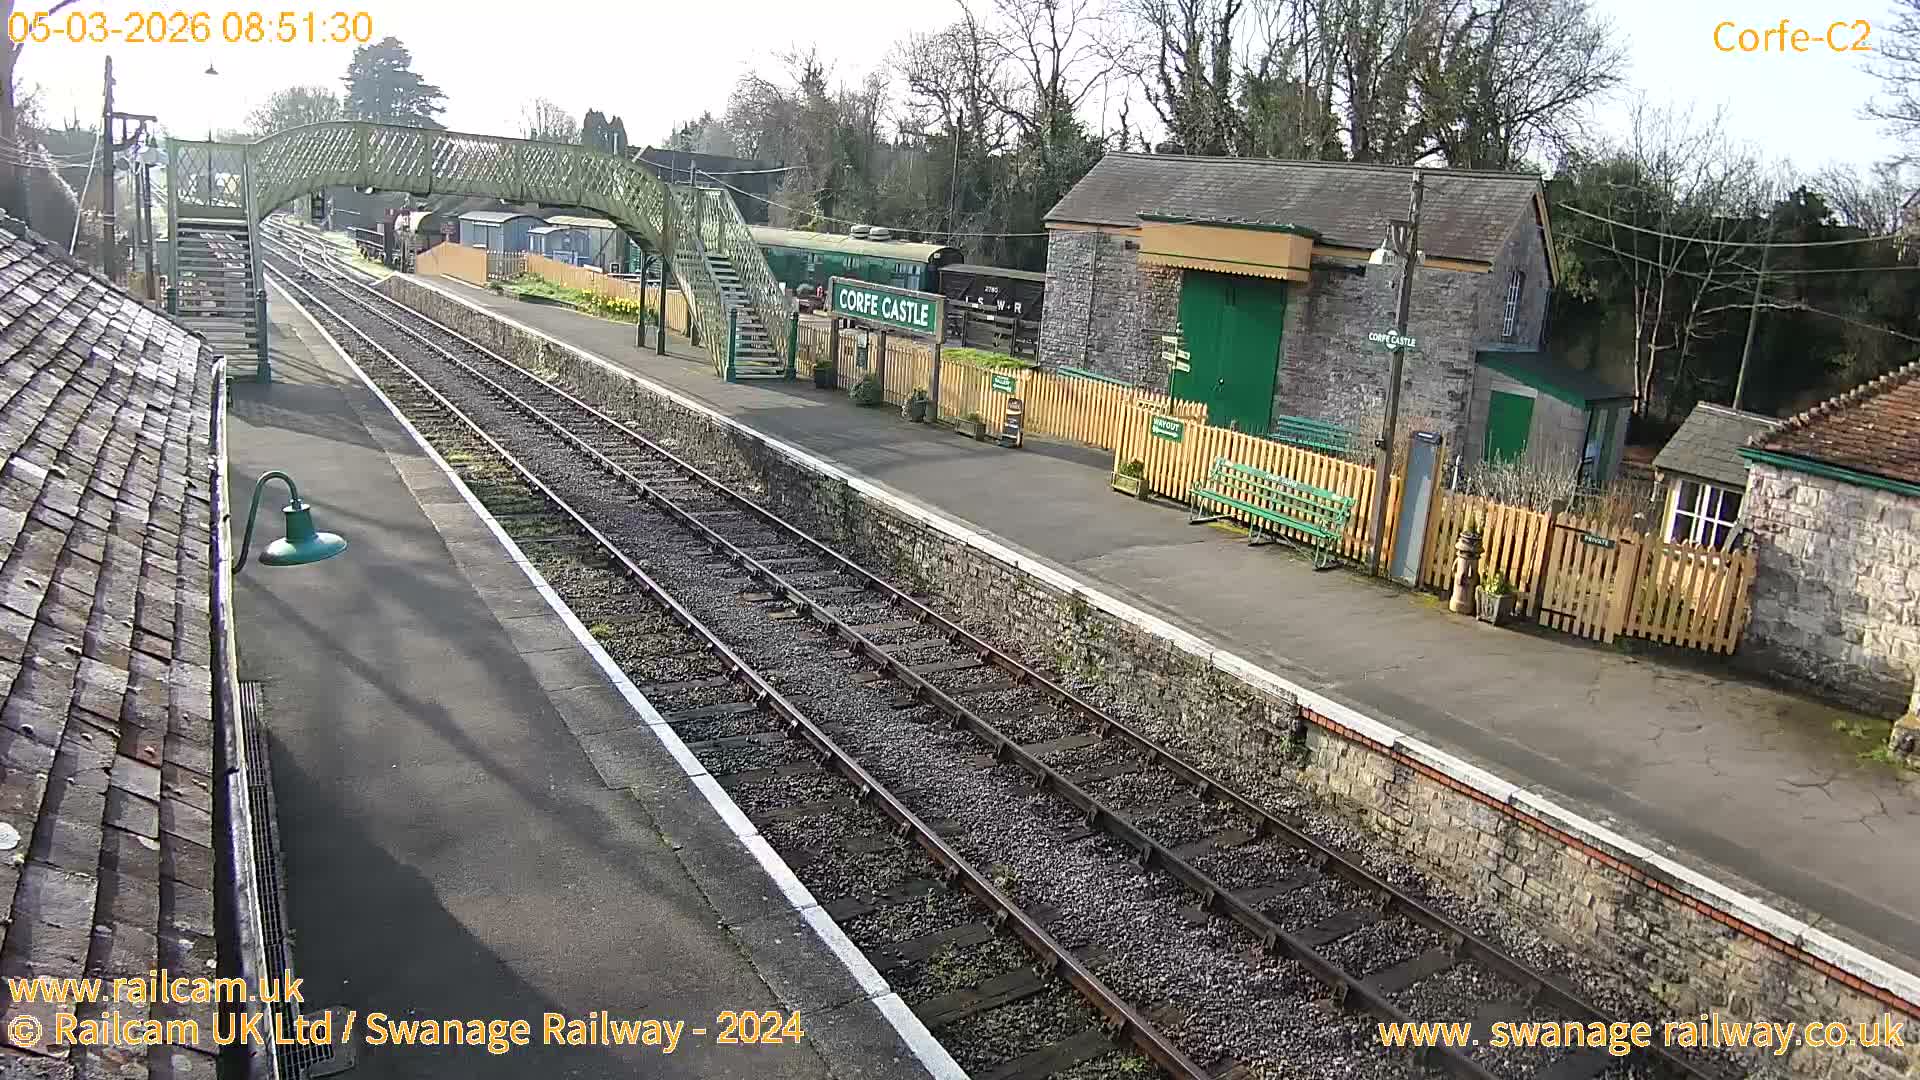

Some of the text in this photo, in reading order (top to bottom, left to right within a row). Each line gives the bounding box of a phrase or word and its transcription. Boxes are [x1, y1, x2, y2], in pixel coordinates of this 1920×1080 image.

[839, 288, 929, 327] CORFE CASTLE
[1368, 332, 1417, 347] CORFE CASTLE
[1584, 535, 1609, 547] PRIVATE
